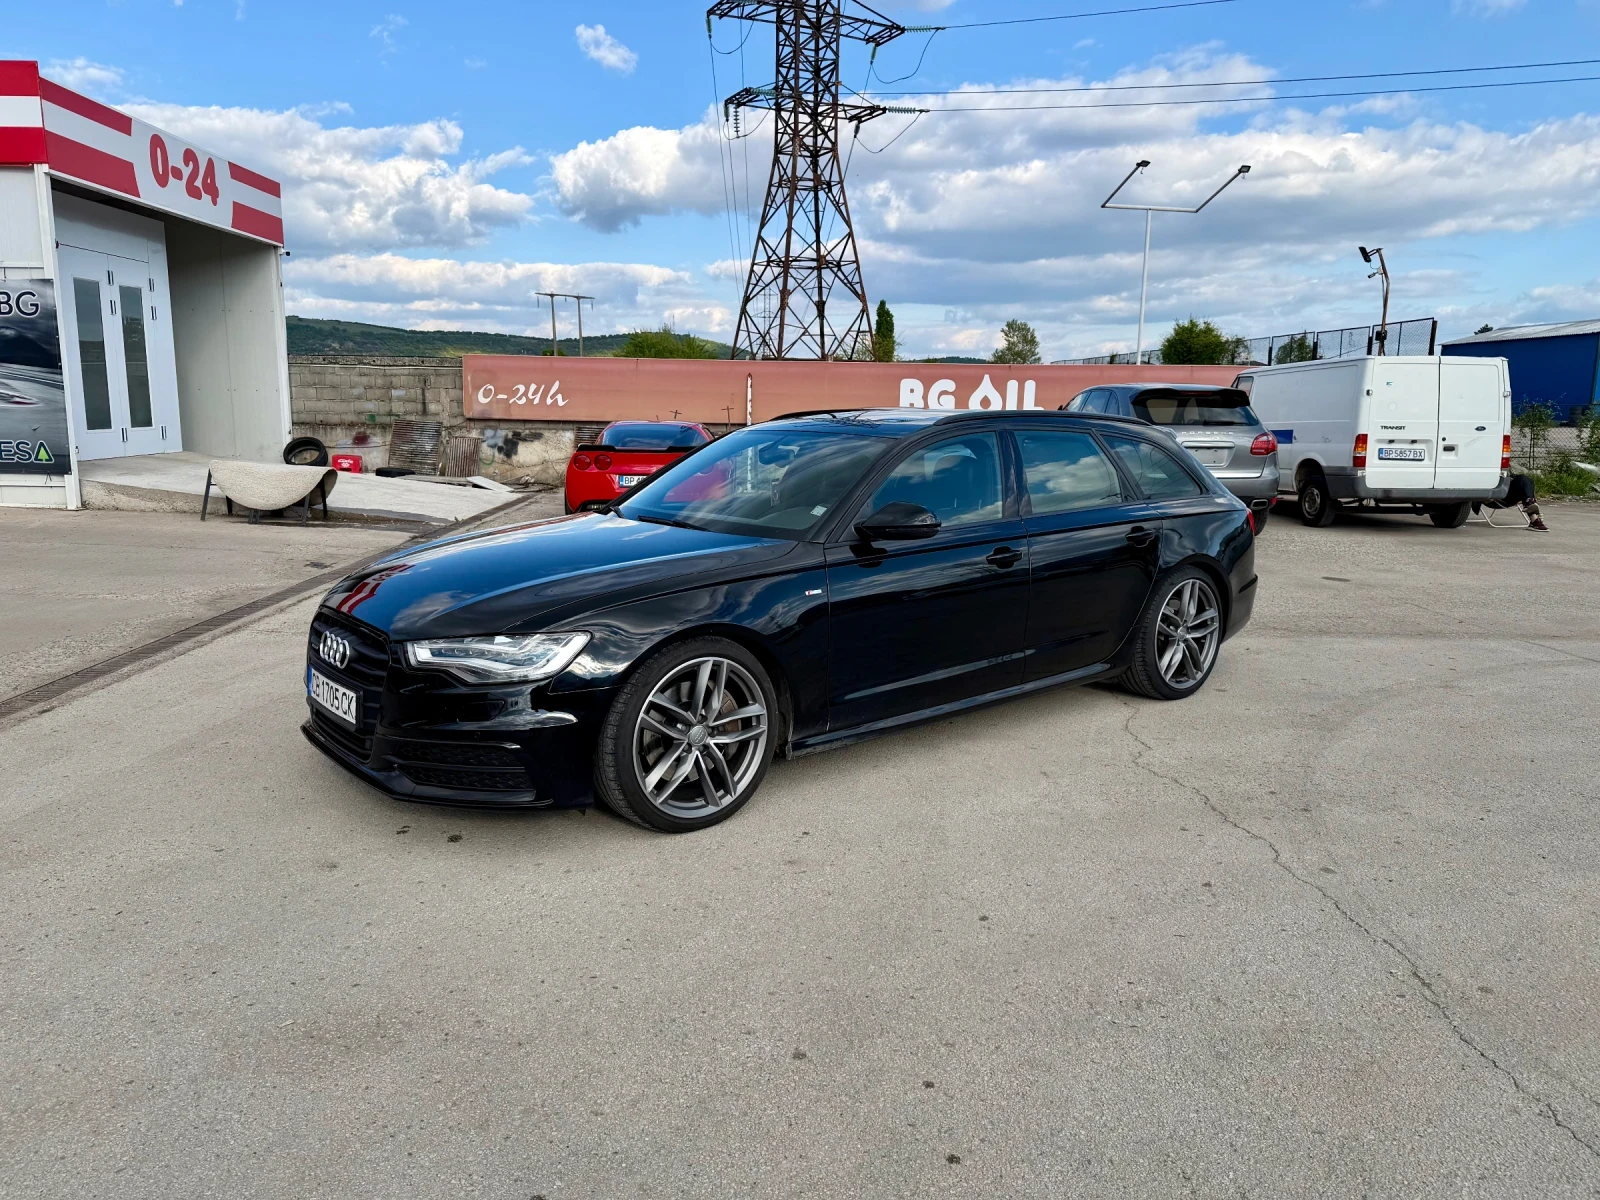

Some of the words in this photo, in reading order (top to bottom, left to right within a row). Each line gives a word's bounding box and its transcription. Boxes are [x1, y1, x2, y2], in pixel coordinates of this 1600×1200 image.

[150, 133, 219, 206] 0-24
[478, 380, 569, 407] 0-24h
[899, 378, 956, 409] BG
[968, 374, 1045, 410] OIL
[321, 679, 340, 711] 1705
[340, 691, 355, 719] CK
